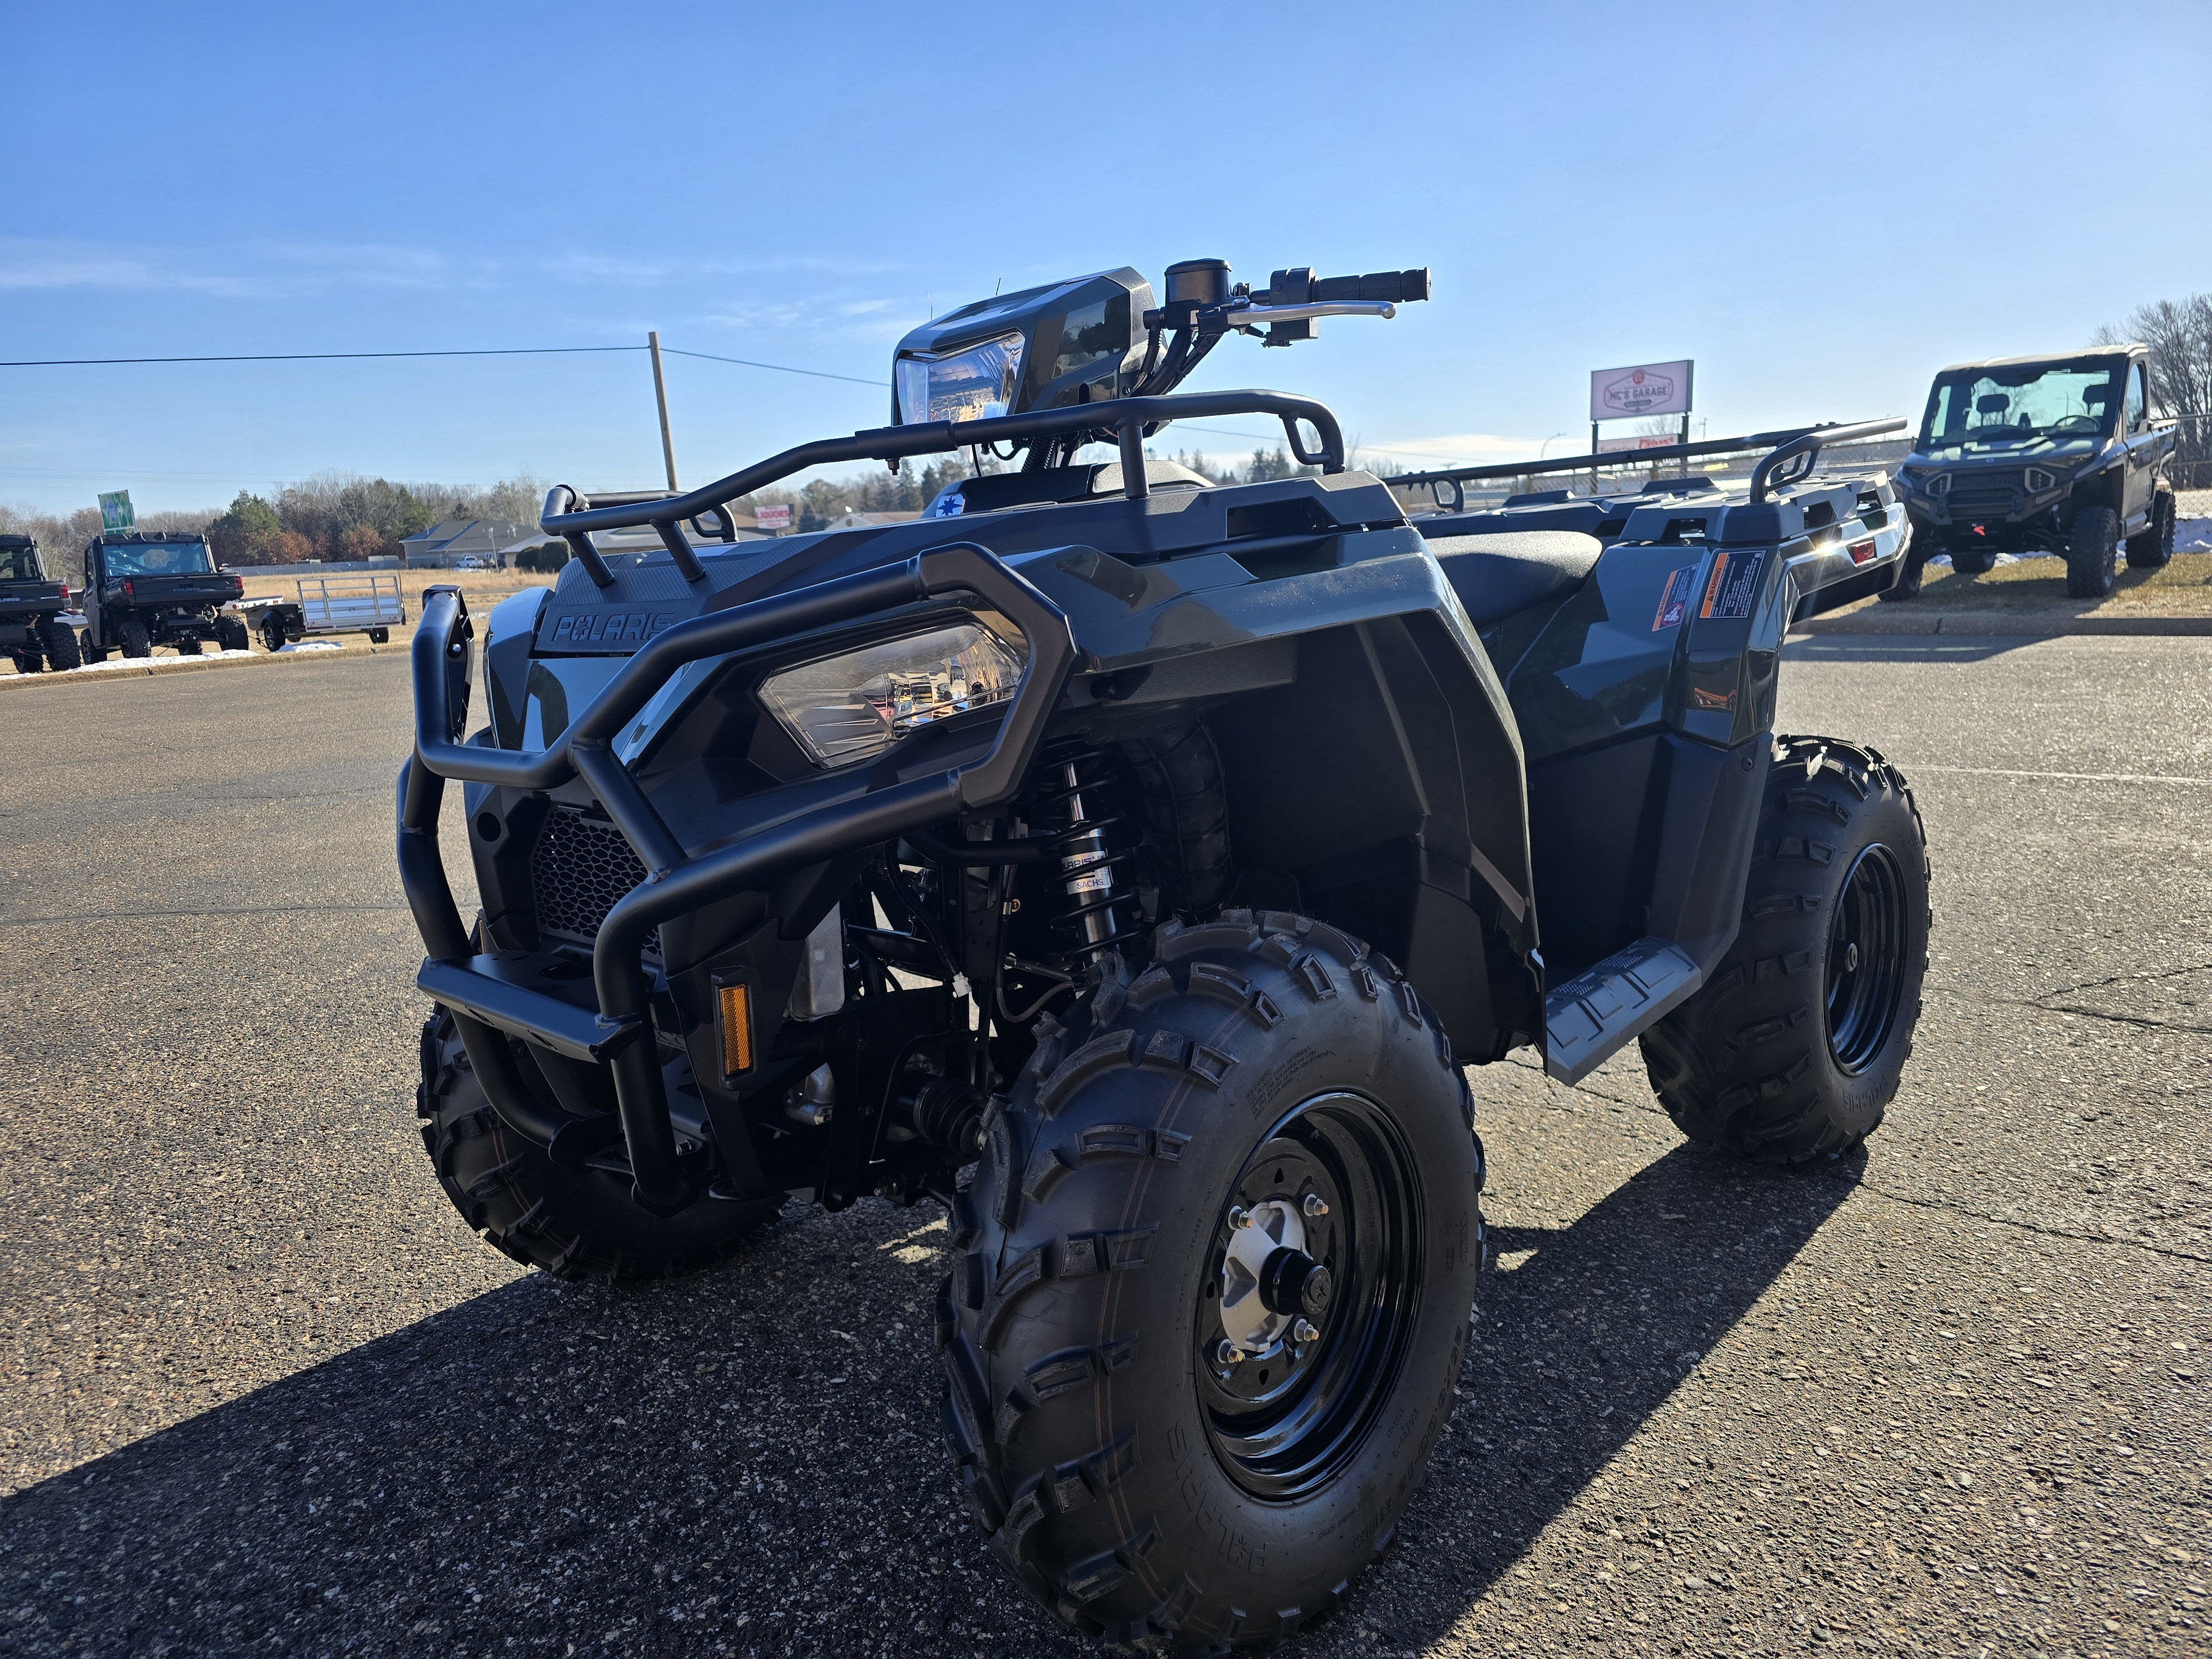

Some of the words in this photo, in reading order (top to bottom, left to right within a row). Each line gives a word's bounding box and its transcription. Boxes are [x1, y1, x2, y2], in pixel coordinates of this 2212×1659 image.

[1633, 386, 1667, 398] GARAGE
[755, 510, 789, 519] LIQUORS
[1708, 567, 1722, 596] WARNING
[551, 612, 674, 641] POLARIS
[1077, 879, 1103, 889] SACHS
[1843, 1073, 1887, 1113] POLARIS
[1391, 1407, 1420, 1459] 205/80-12
[1167, 1417, 1270, 1575] POLARIS
